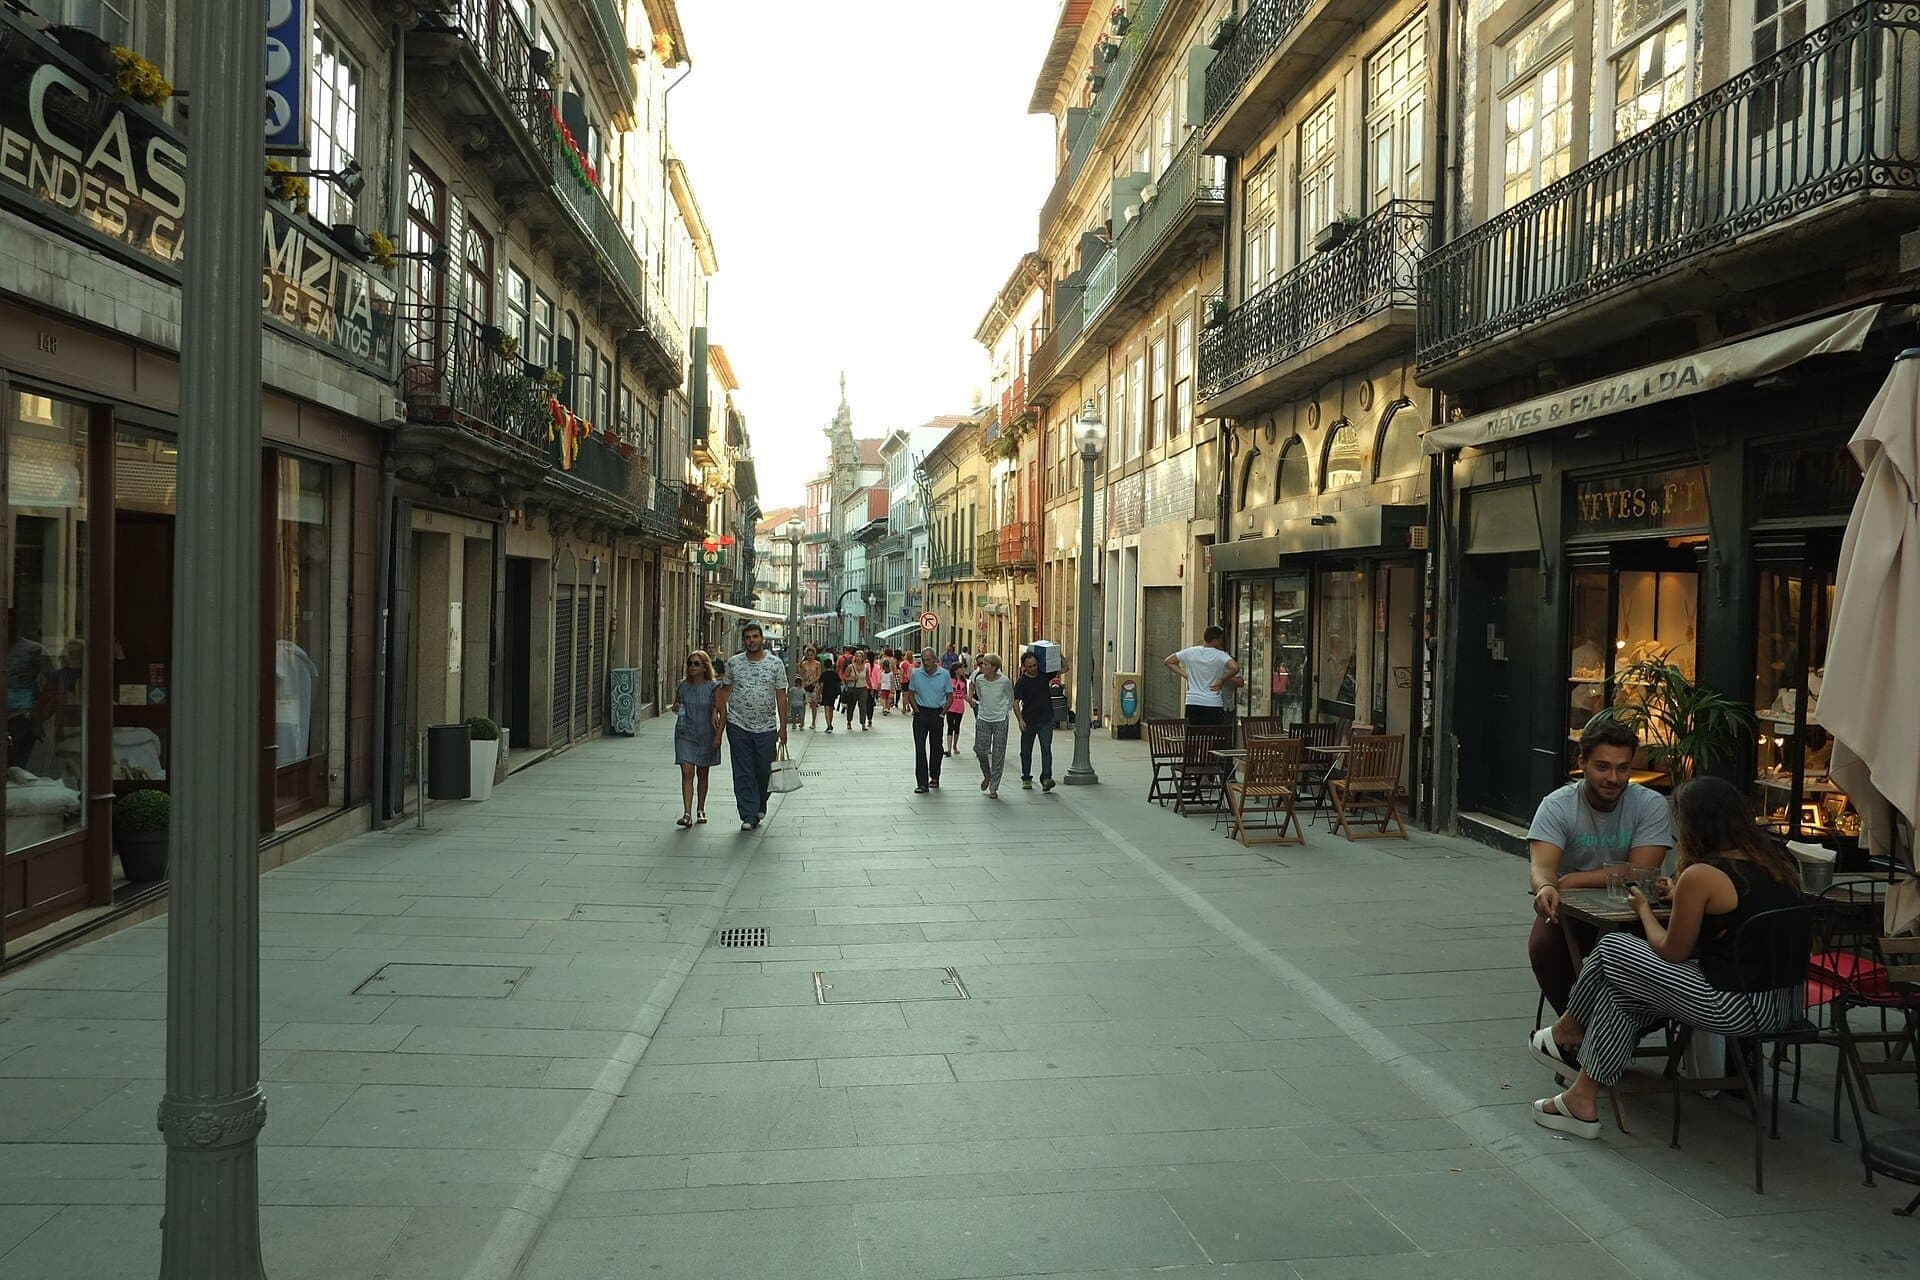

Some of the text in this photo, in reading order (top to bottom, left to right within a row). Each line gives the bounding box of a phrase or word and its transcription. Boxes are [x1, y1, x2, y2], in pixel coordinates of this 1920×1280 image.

[29, 63, 188, 220] CAS
[0, 125, 133, 244] ENDES,
[304, 298, 372, 359] SANTOS
[1486, 407, 1543, 437] NEVES
[1547, 403, 1563, 423] &
